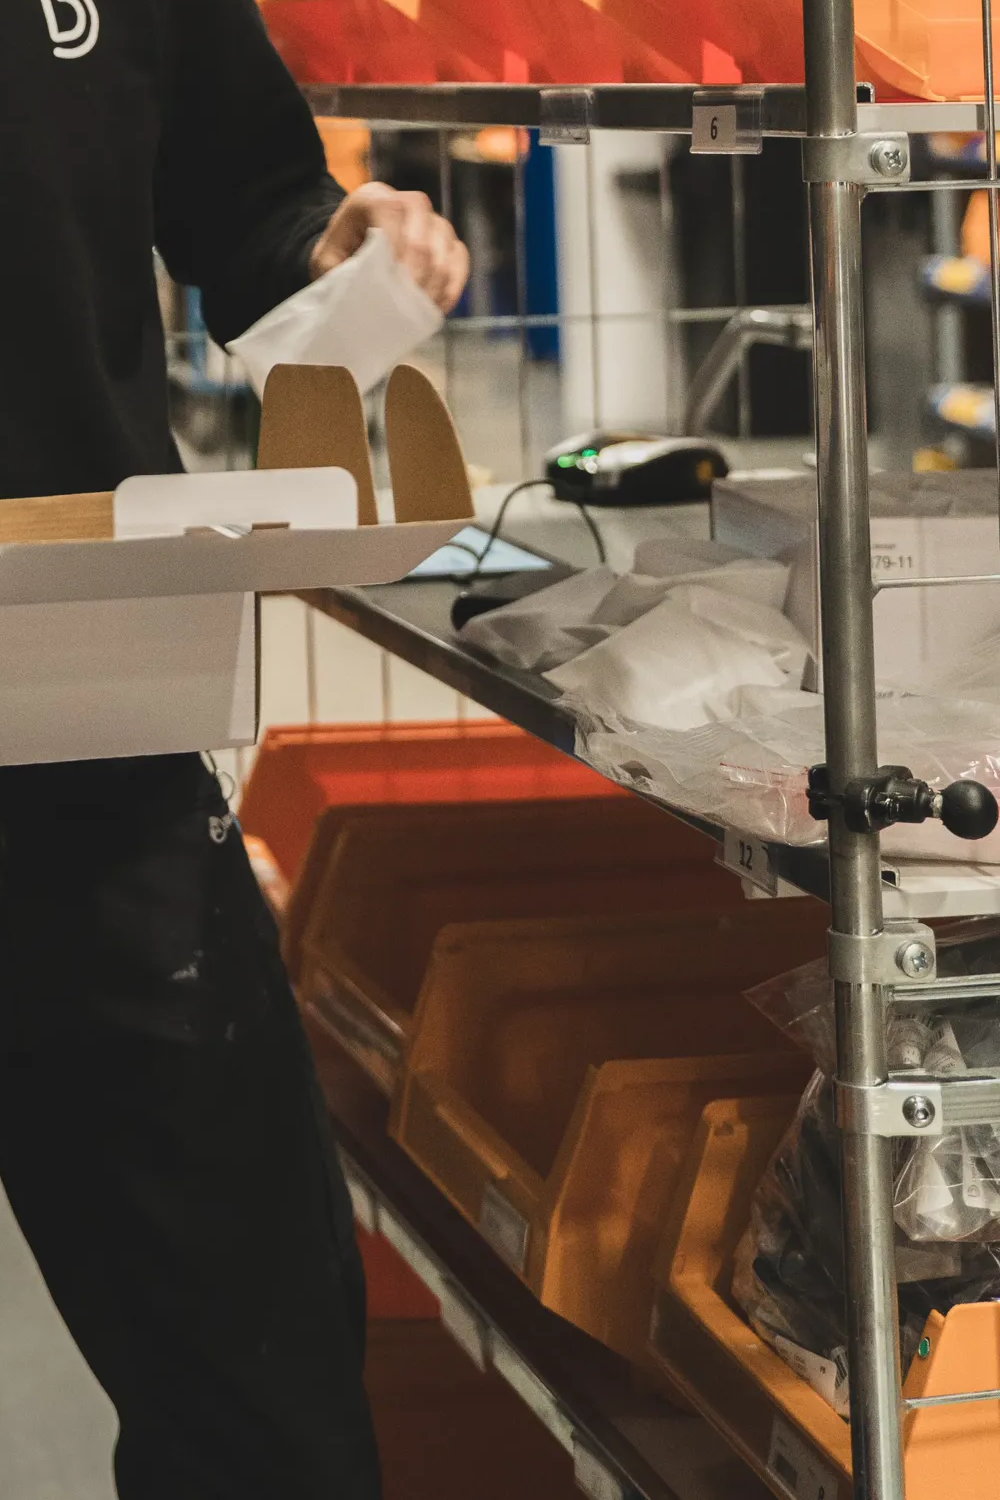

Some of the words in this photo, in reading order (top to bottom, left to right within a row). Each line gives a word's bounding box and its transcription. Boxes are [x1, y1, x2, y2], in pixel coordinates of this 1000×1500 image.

[710, 116, 718, 140] 6
[871, 554, 913, 570] 79-11
[739, 840, 753, 871] 12
